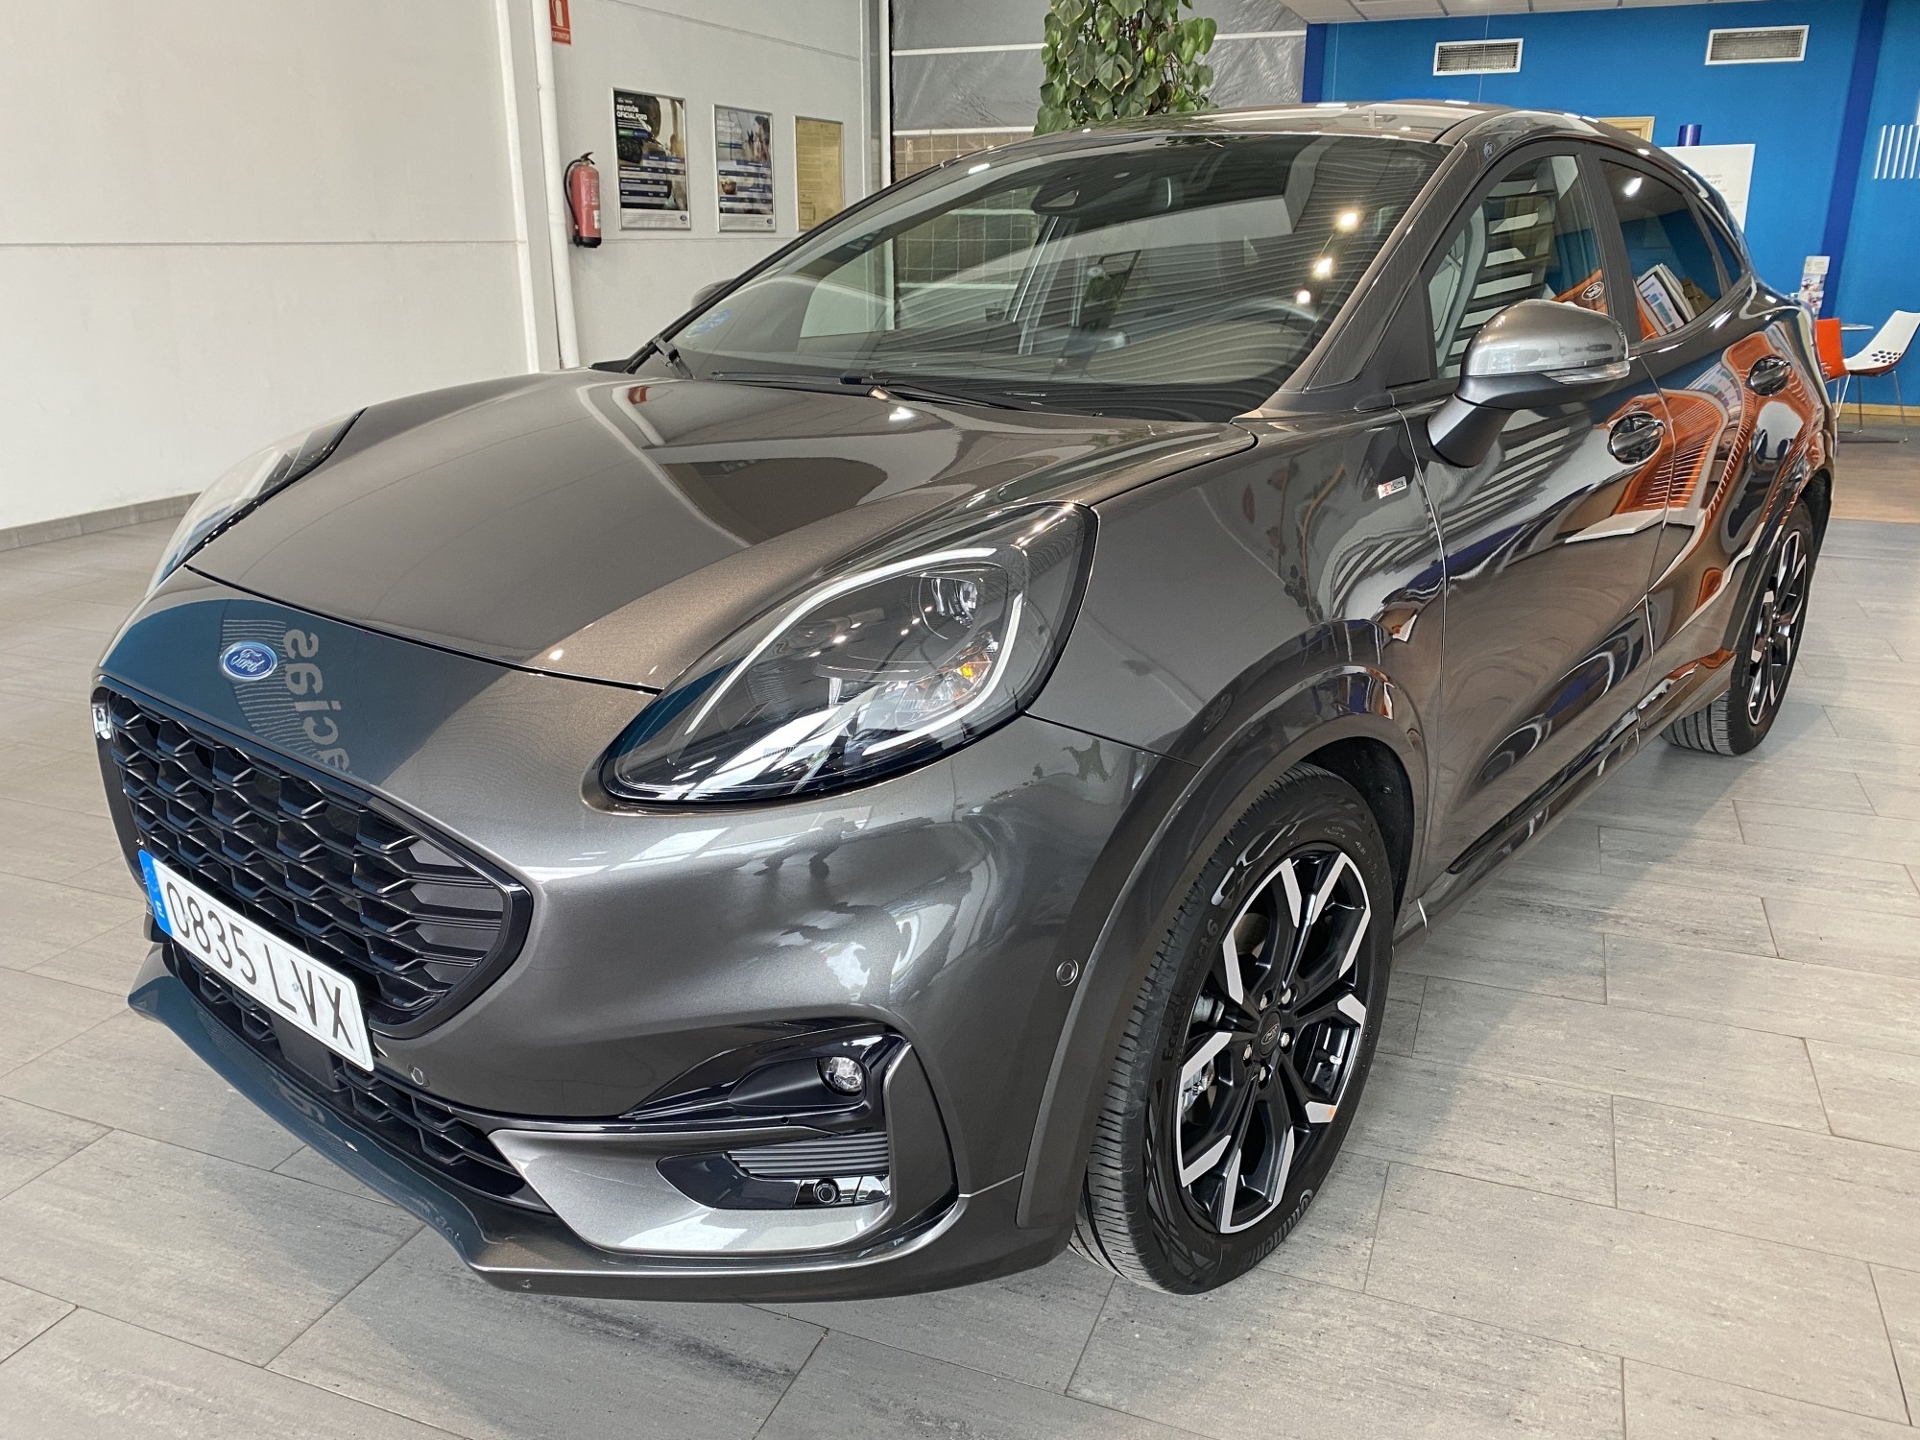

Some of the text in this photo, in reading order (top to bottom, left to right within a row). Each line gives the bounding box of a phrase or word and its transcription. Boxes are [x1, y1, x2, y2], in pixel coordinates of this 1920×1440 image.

[230, 648, 266, 673] Ford
[155, 900, 165, 919] E
[166, 881, 355, 1050] 0835 LVX
